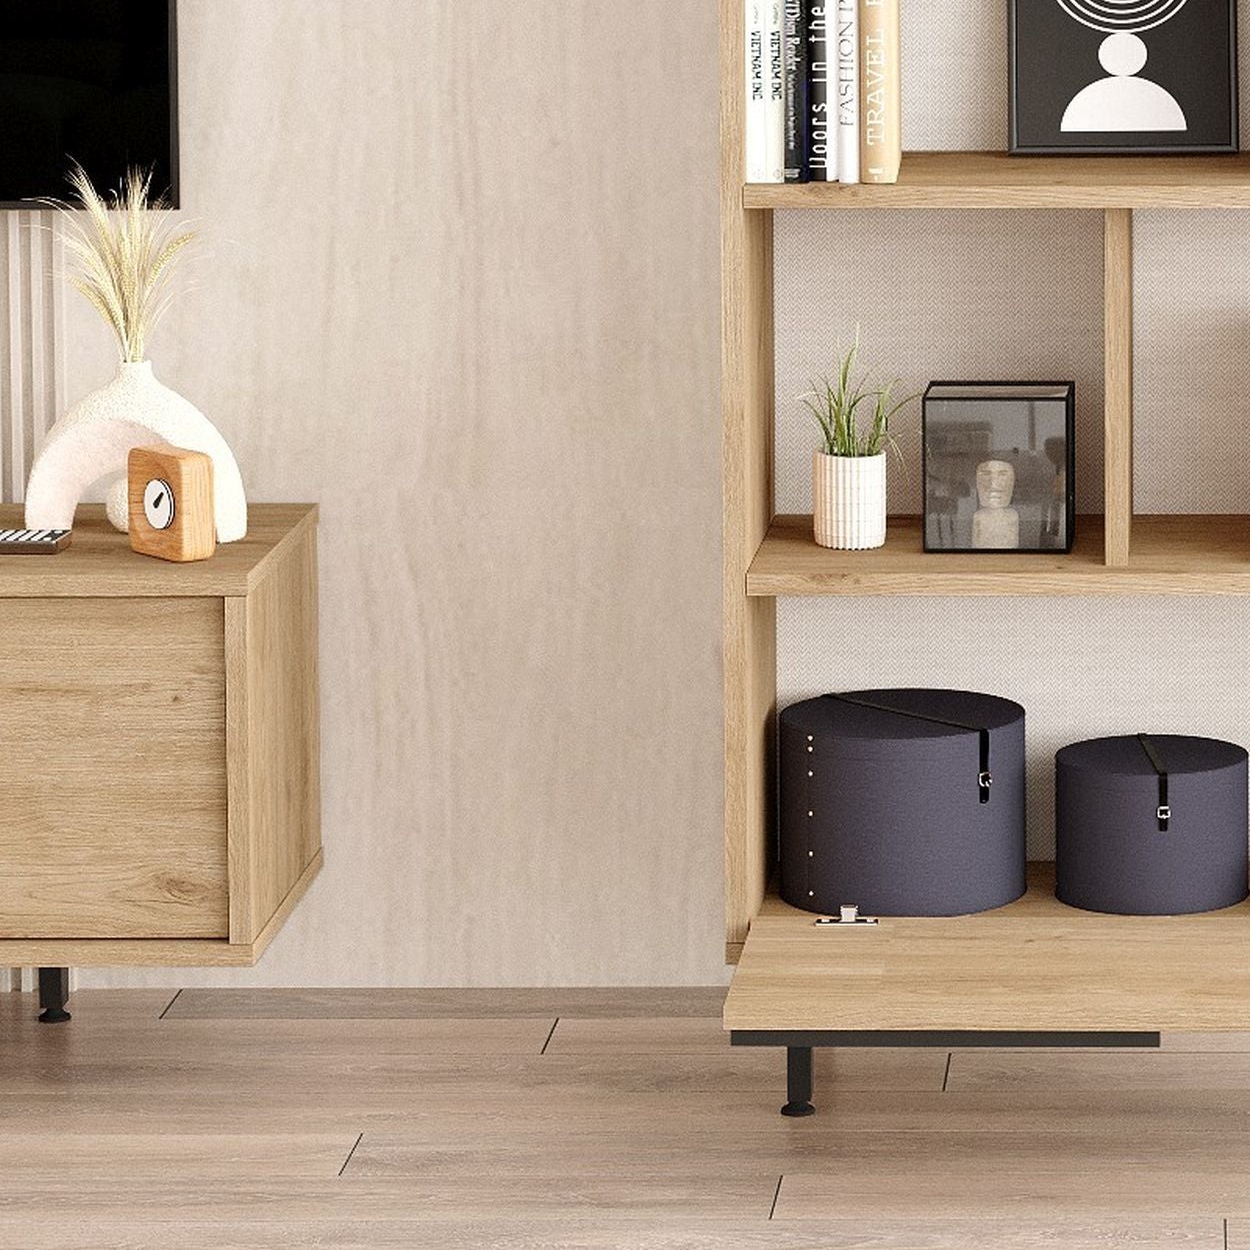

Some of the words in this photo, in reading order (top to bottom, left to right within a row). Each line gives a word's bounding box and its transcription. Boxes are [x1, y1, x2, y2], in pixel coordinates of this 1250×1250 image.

[808, 5, 828, 43] the
[751, 30, 762, 79] VIETNAM
[771, 30, 782, 79] VIETNAM
[838, 20, 855, 127] FASHION
[866, 28, 884, 146] TRAVEL
